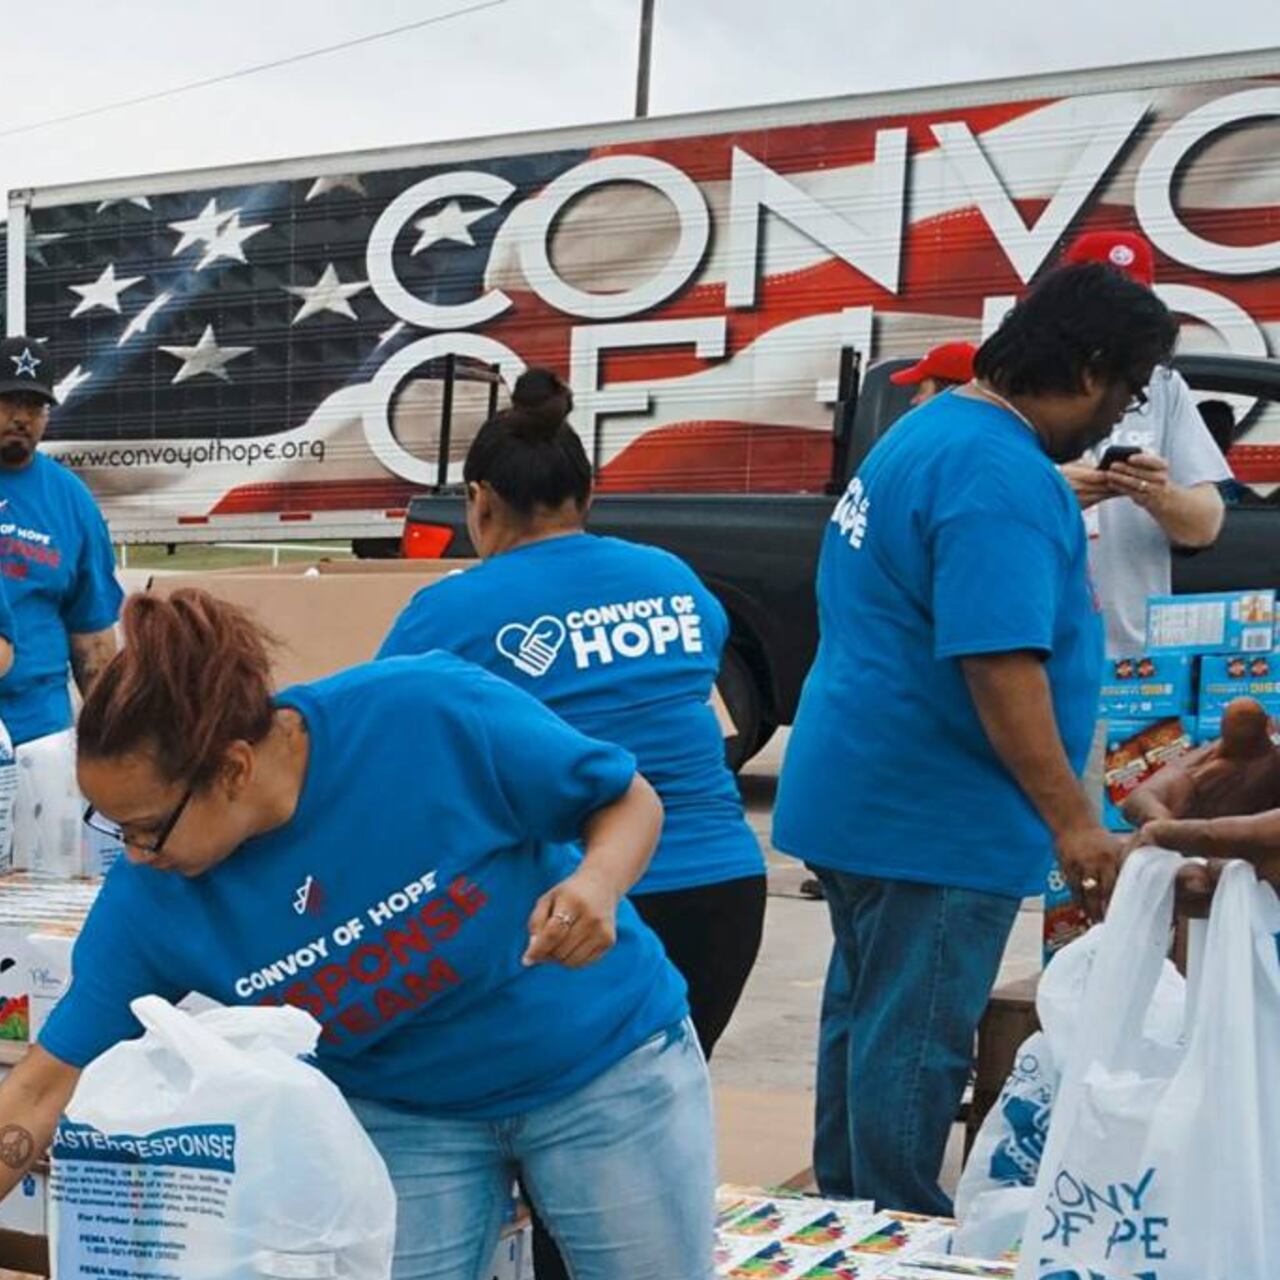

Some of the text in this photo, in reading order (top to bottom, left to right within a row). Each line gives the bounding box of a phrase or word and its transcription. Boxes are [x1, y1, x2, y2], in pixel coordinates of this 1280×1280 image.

[363, 316, 728, 485] OF
[18, 528, 51, 545] HOPE
[566, 595, 695, 630] CONVOY OF
[569, 615, 703, 669] HOPE
[235, 870, 438, 997] CONVOY OF HOPE
[258, 875, 489, 1018] SPONSE
